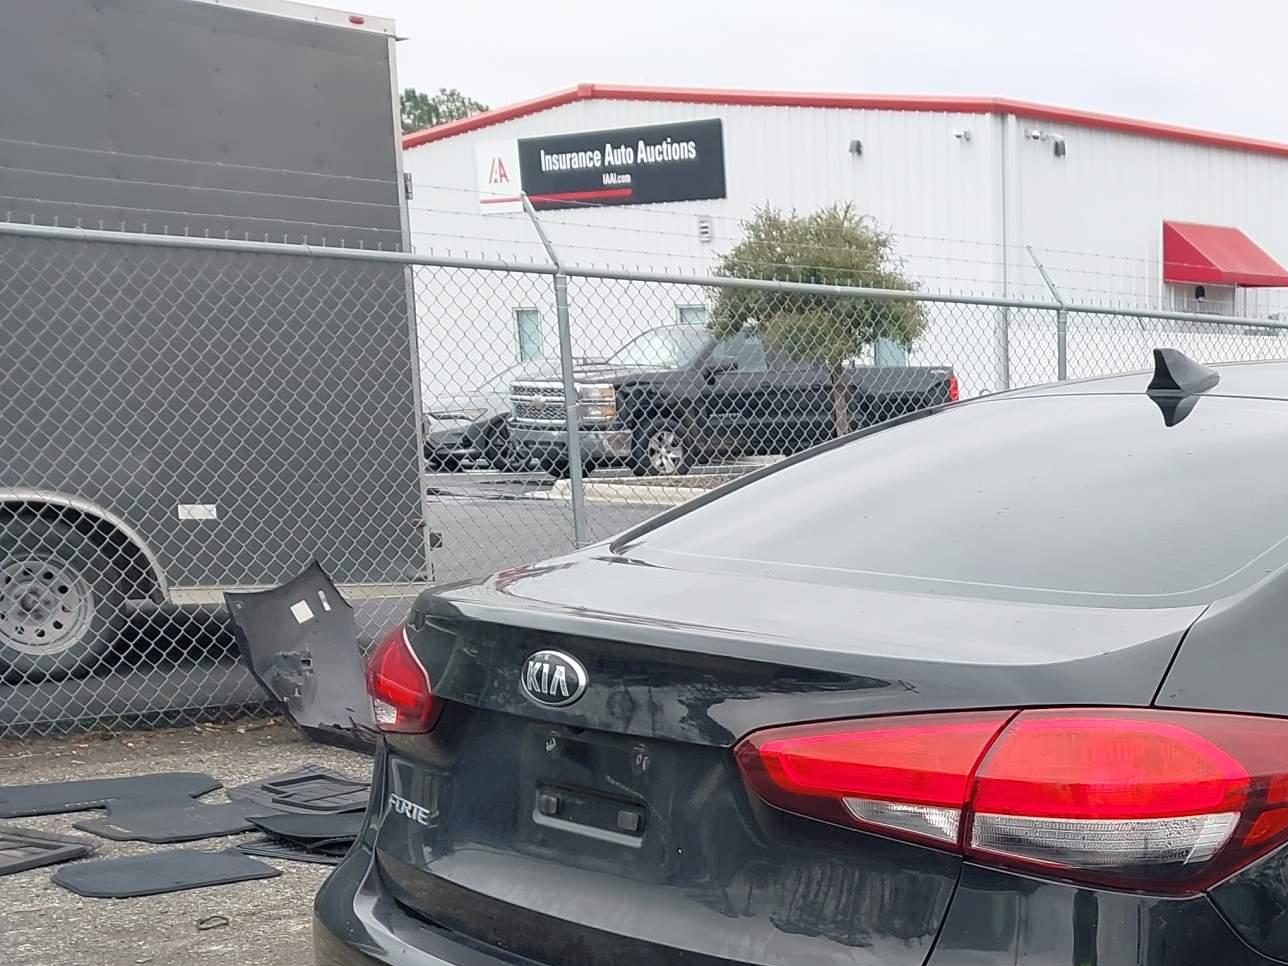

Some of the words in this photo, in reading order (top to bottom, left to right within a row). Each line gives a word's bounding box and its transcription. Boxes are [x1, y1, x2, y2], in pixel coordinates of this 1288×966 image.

[540, 149, 601, 171] Insurance
[604, 143, 634, 166] Auto
[637, 138, 697, 163] Auctions
[527, 660, 569, 697] KIA
[389, 793, 430, 825] FORTE
